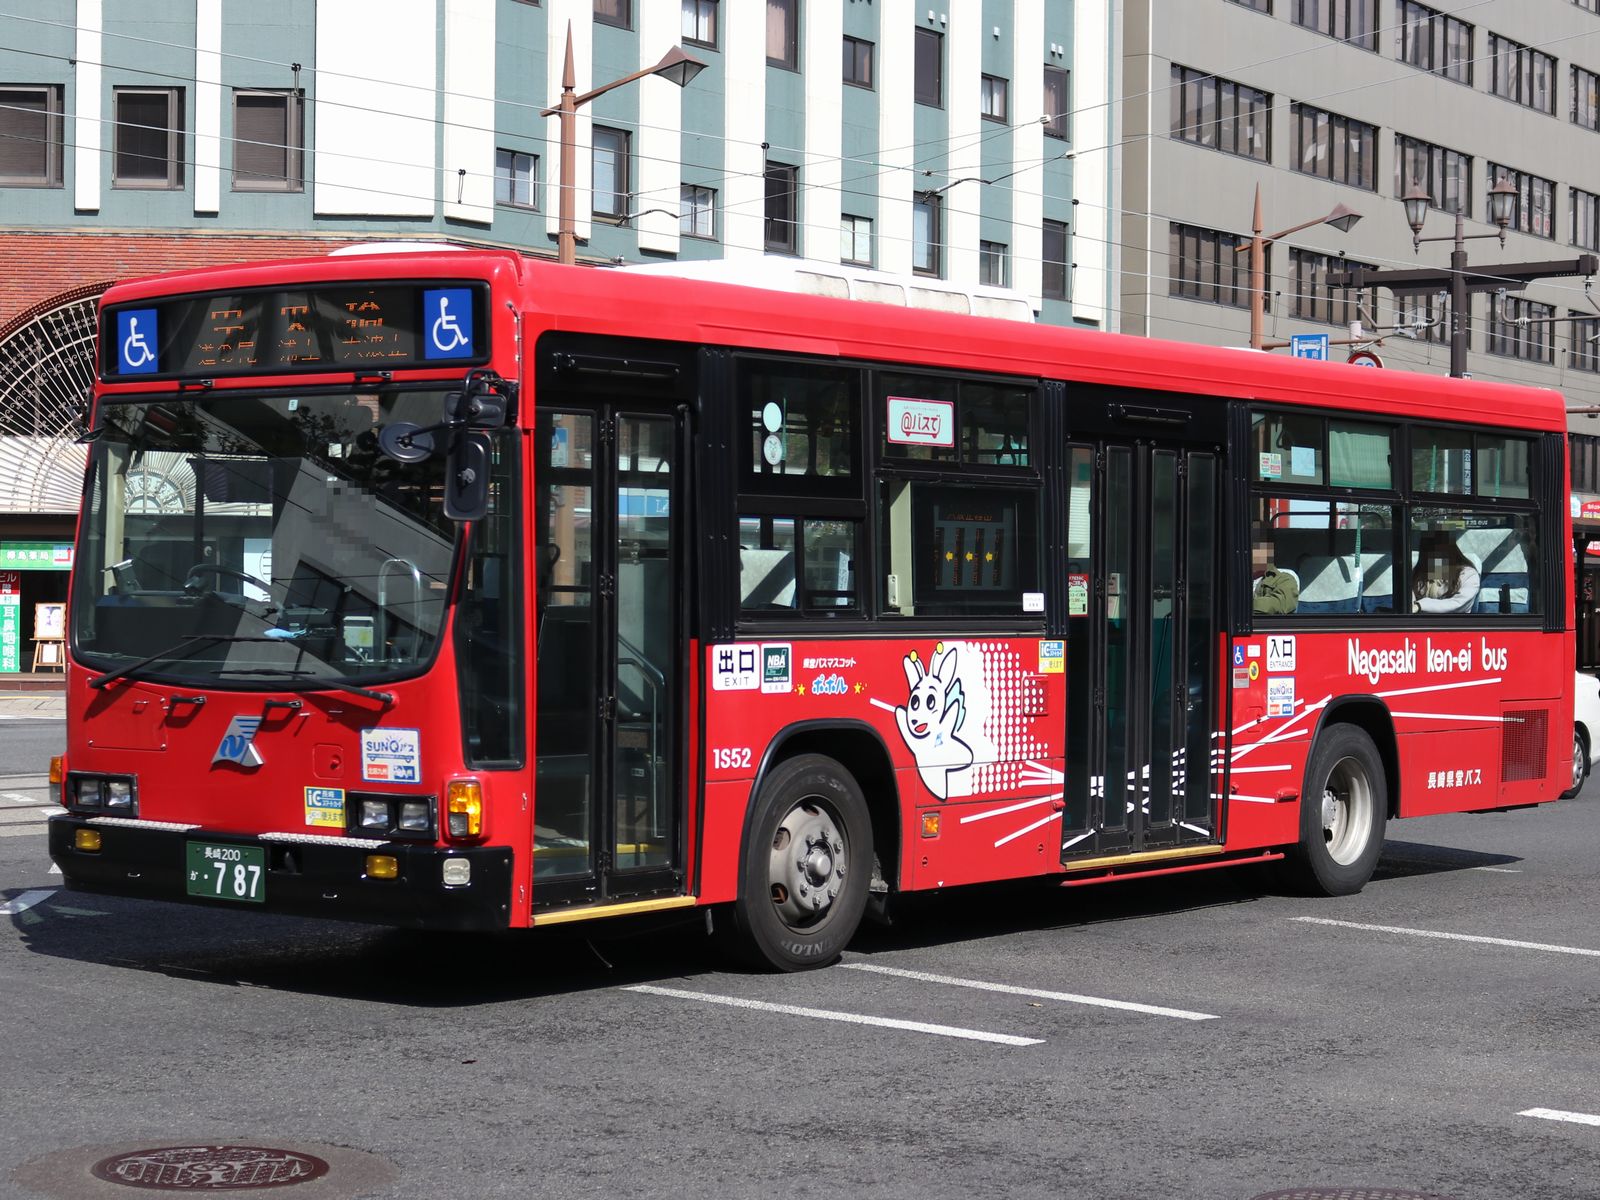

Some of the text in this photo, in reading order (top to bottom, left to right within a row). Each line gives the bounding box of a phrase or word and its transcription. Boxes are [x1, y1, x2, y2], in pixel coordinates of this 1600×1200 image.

[1270, 639, 1293, 658] 入口
[719, 649, 754, 674] 出口
[768, 654, 786, 666] NBA
[803, 657, 857, 669] 県営バスマスコット
[1269, 660, 1293, 669] ENTRANCE
[1348, 636, 1508, 685] Nagasaki ken-ei bus
[724, 676, 750, 687] EXIT
[713, 747, 752, 769] 1S52
[1427, 769, 1482, 789] 長崎県営バス
